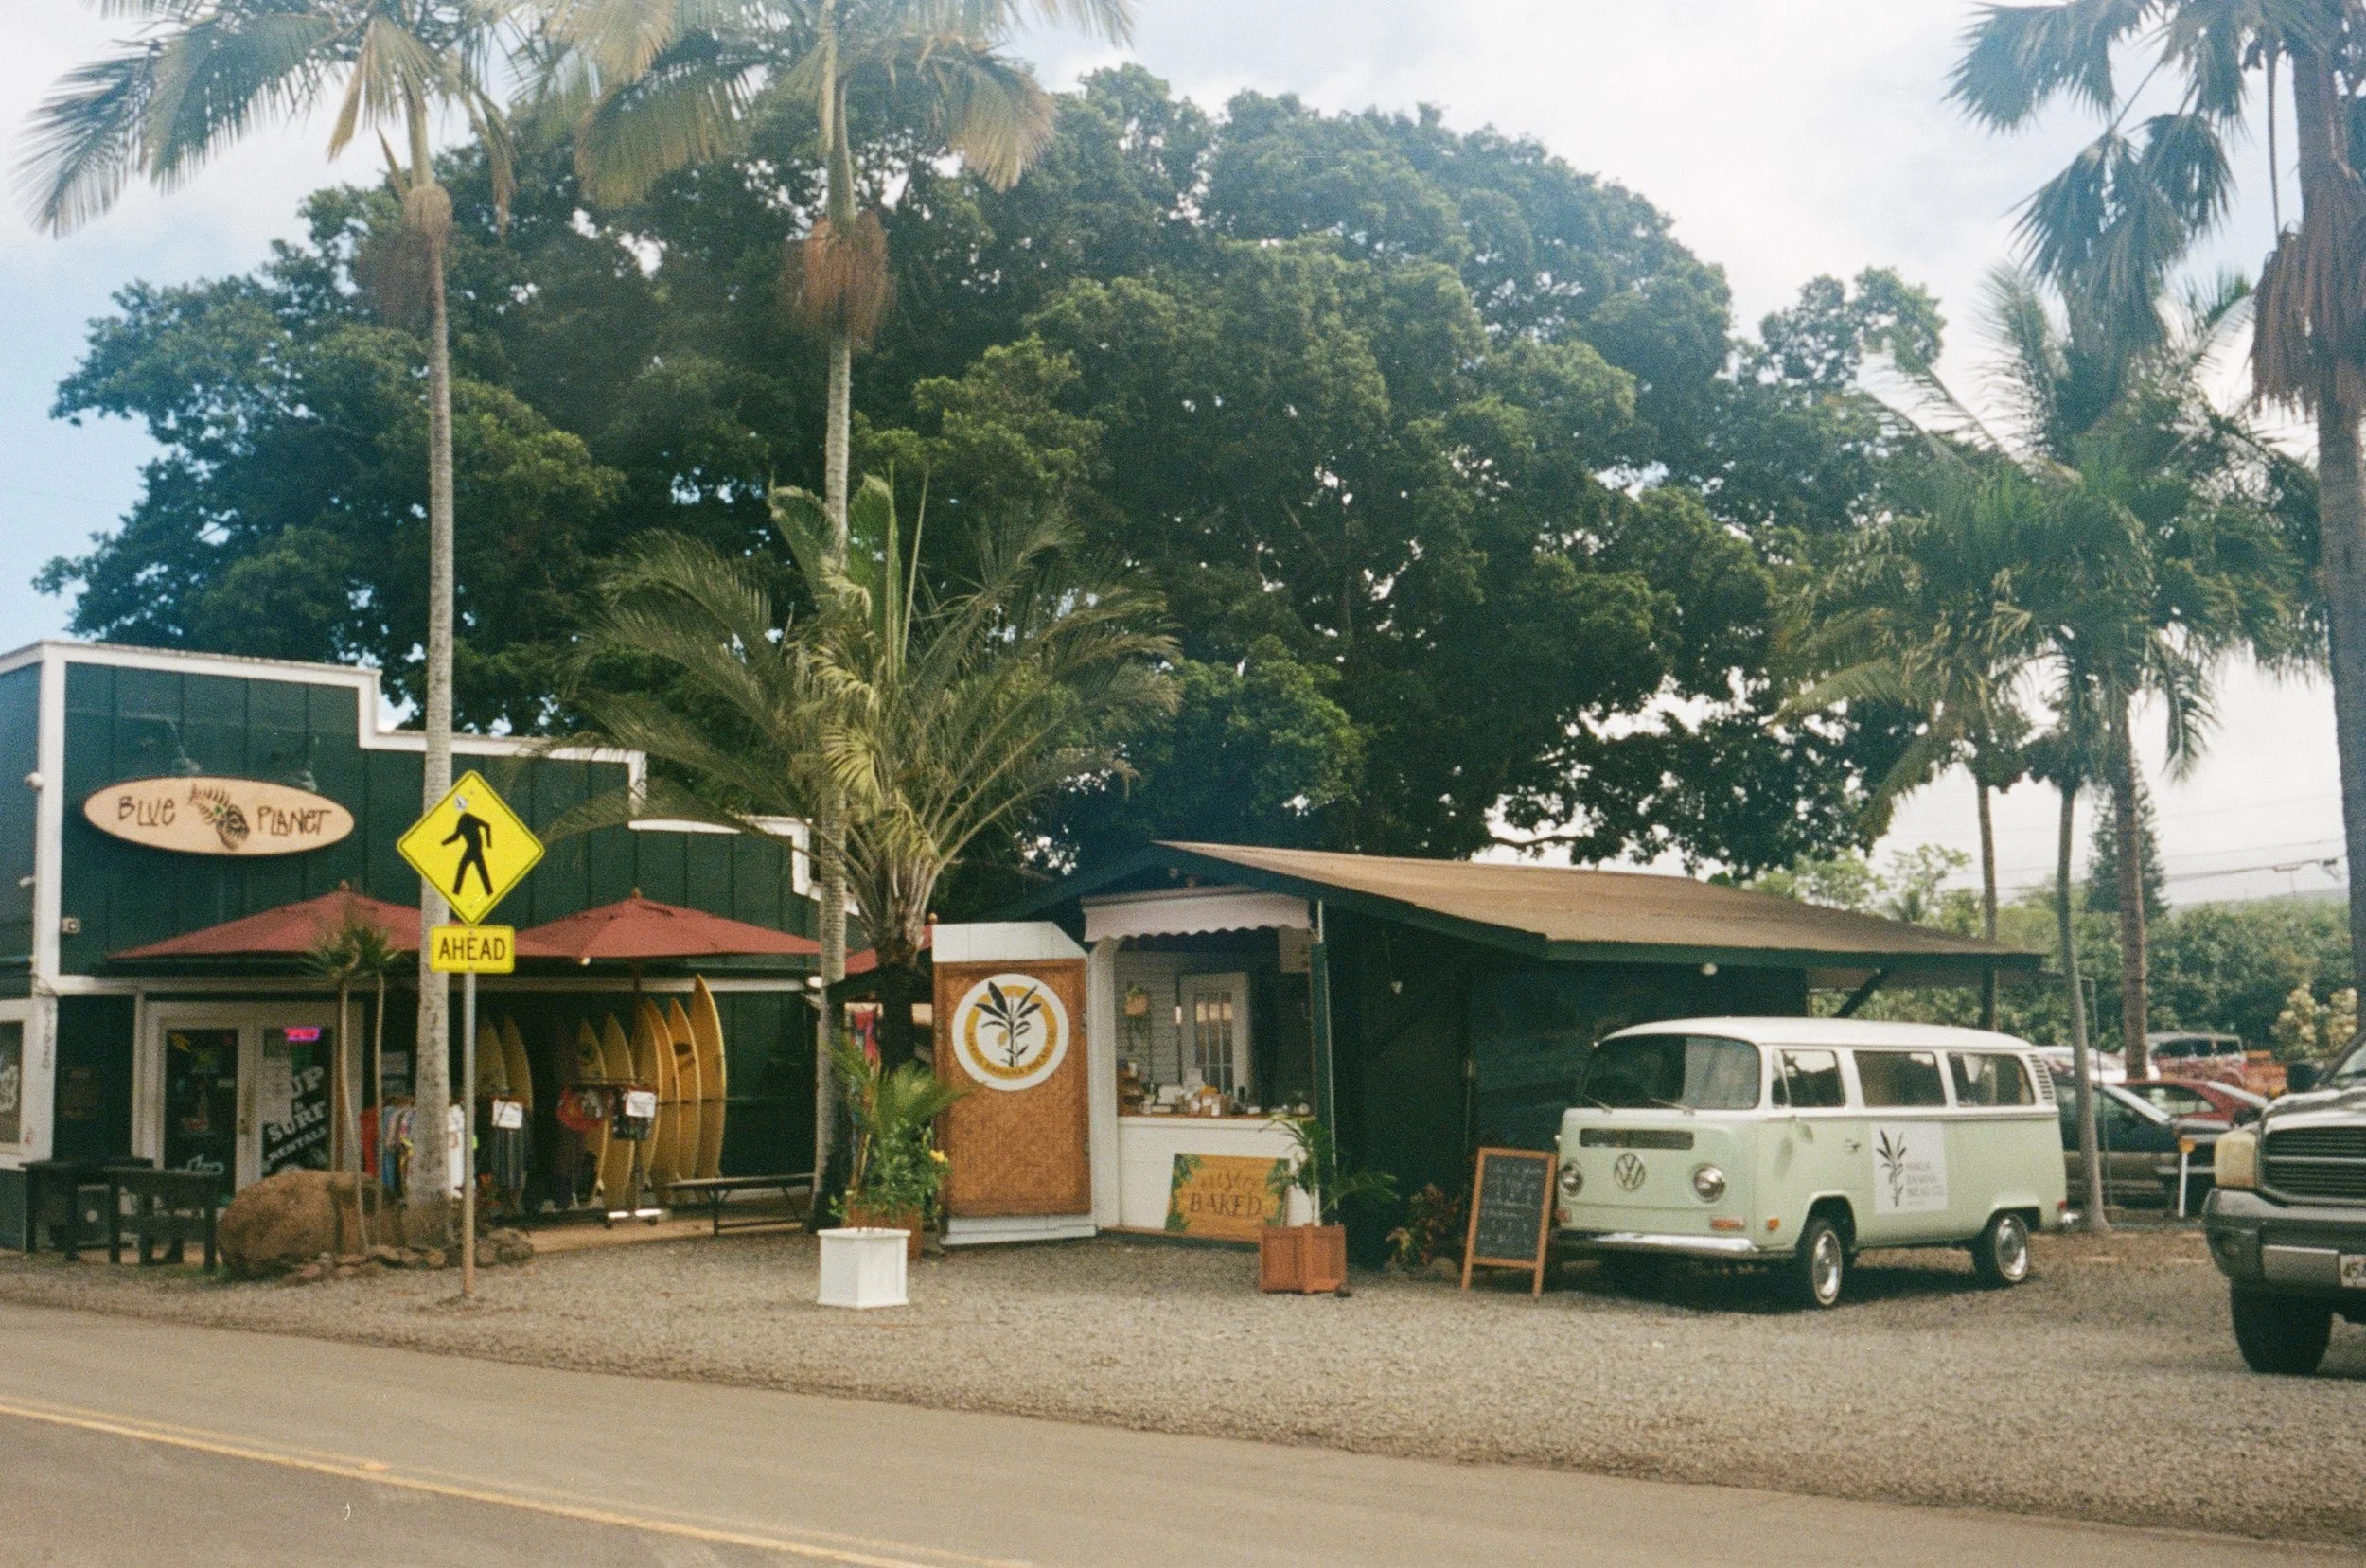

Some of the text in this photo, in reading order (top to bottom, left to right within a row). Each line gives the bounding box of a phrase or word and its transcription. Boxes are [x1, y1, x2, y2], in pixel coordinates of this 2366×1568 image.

[438, 937, 506, 960] AHEAD
[268, 1100, 327, 1143] SURF
[268, 1125, 327, 1162] RENTALS
[1190, 1192, 1262, 1218] BAKED
